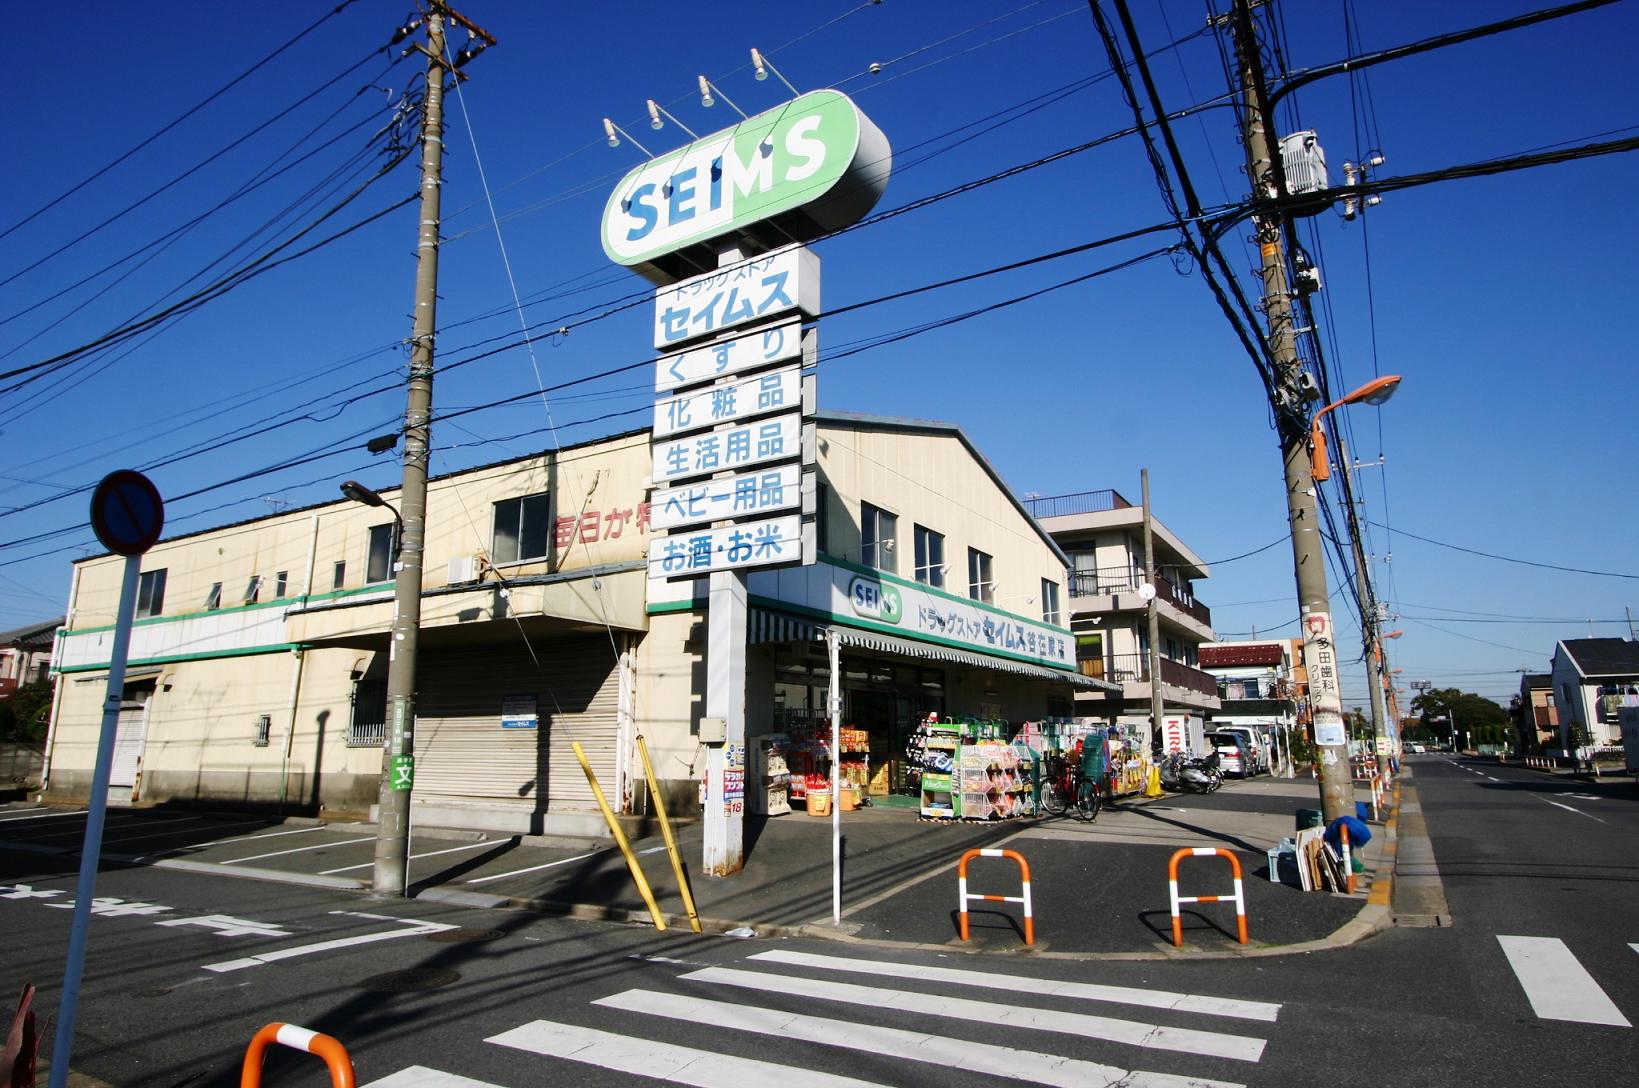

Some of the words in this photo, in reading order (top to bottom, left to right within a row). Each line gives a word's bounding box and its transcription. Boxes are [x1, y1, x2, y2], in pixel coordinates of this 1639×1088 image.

[626, 115, 826, 241] SEIMS
[660, 270, 793, 341] セイムス
[669, 328, 784, 381] くすり
[668, 372, 784, 430] 化粧品
[665, 422, 783, 476] 生活用品
[664, 472, 783, 518] ベビー用品
[662, 524, 782, 572] お酒・お米
[1317, 637, 1335, 692] 多田歯科
[395, 763, 412, 784] 文
